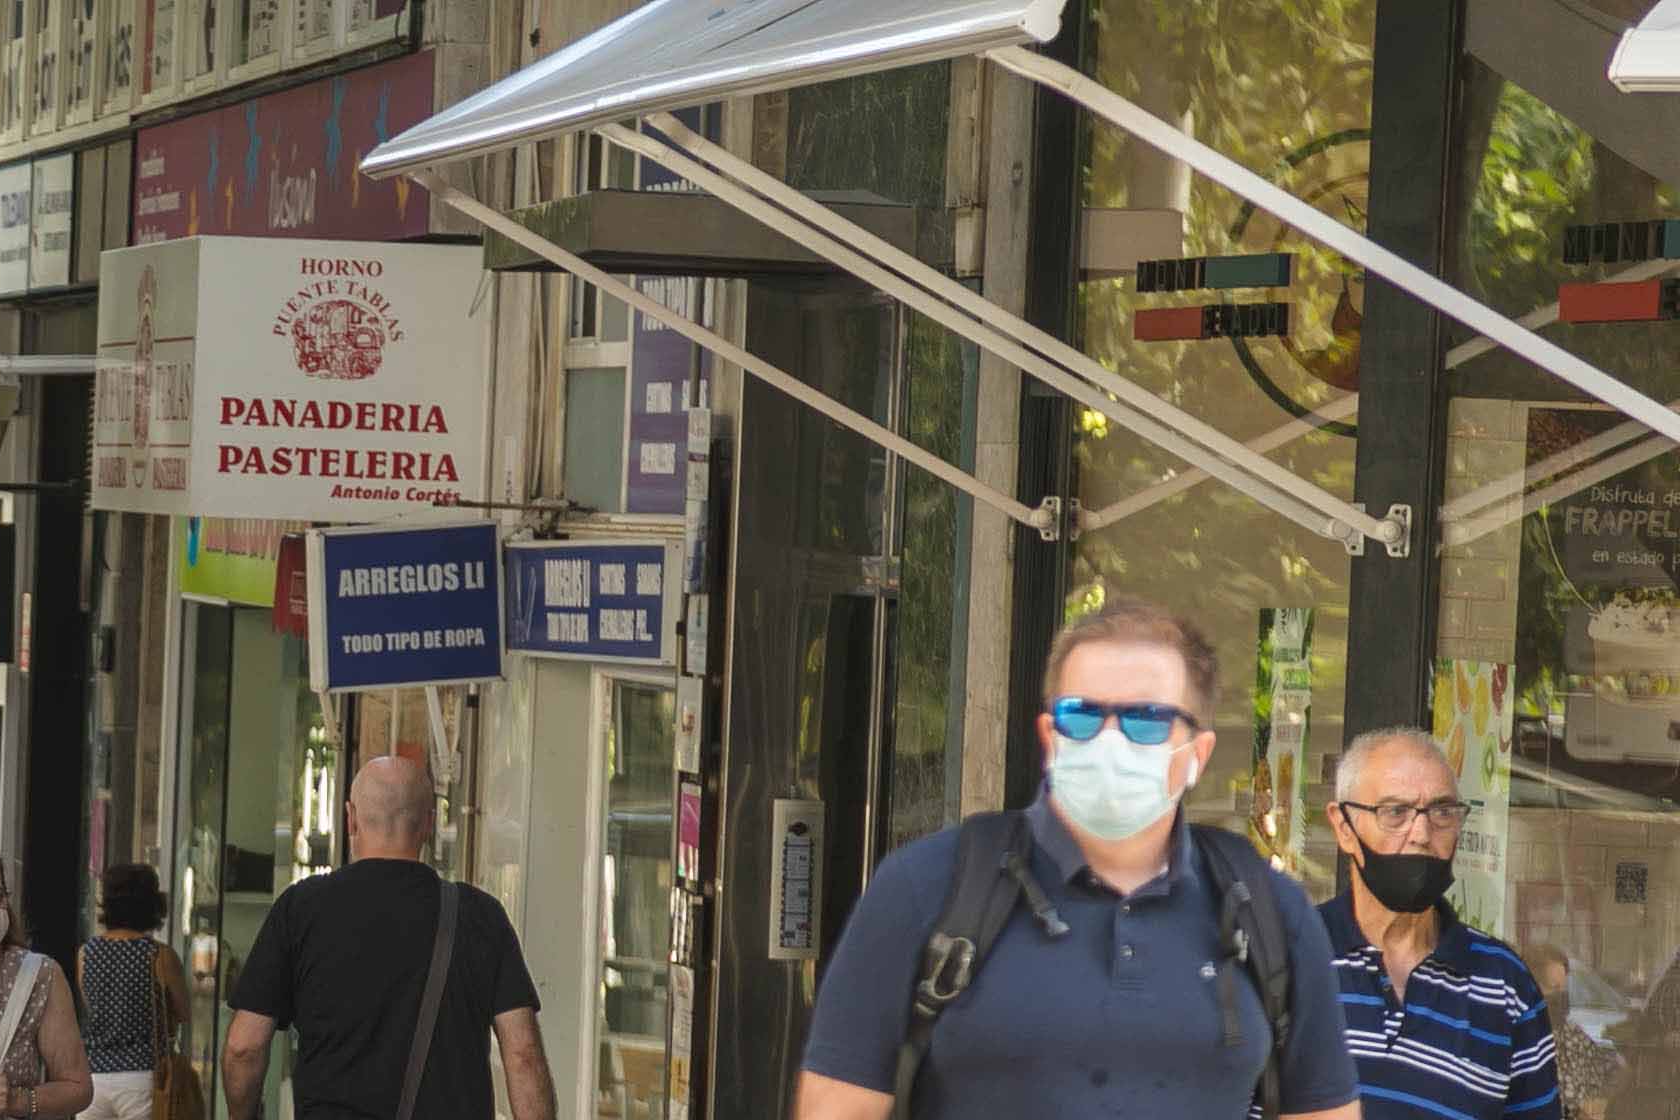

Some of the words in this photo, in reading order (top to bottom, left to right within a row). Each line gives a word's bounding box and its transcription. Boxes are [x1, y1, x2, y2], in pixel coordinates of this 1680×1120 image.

[300, 257, 383, 278] HORNO
[273, 279, 339, 337] PUENTE
[346, 280, 404, 343] TABLAS
[220, 397, 449, 434] PANADERIA
[217, 445, 459, 482] PASTELERIA
[331, 484, 401, 501] Antonio
[338, 562, 459, 597] ARREGLOS
[464, 561, 485, 589] LI
[342, 634, 381, 653] TODO
[384, 631, 420, 651] TIPO
[423, 630, 442, 648] DE
[445, 627, 485, 647] ROPA
